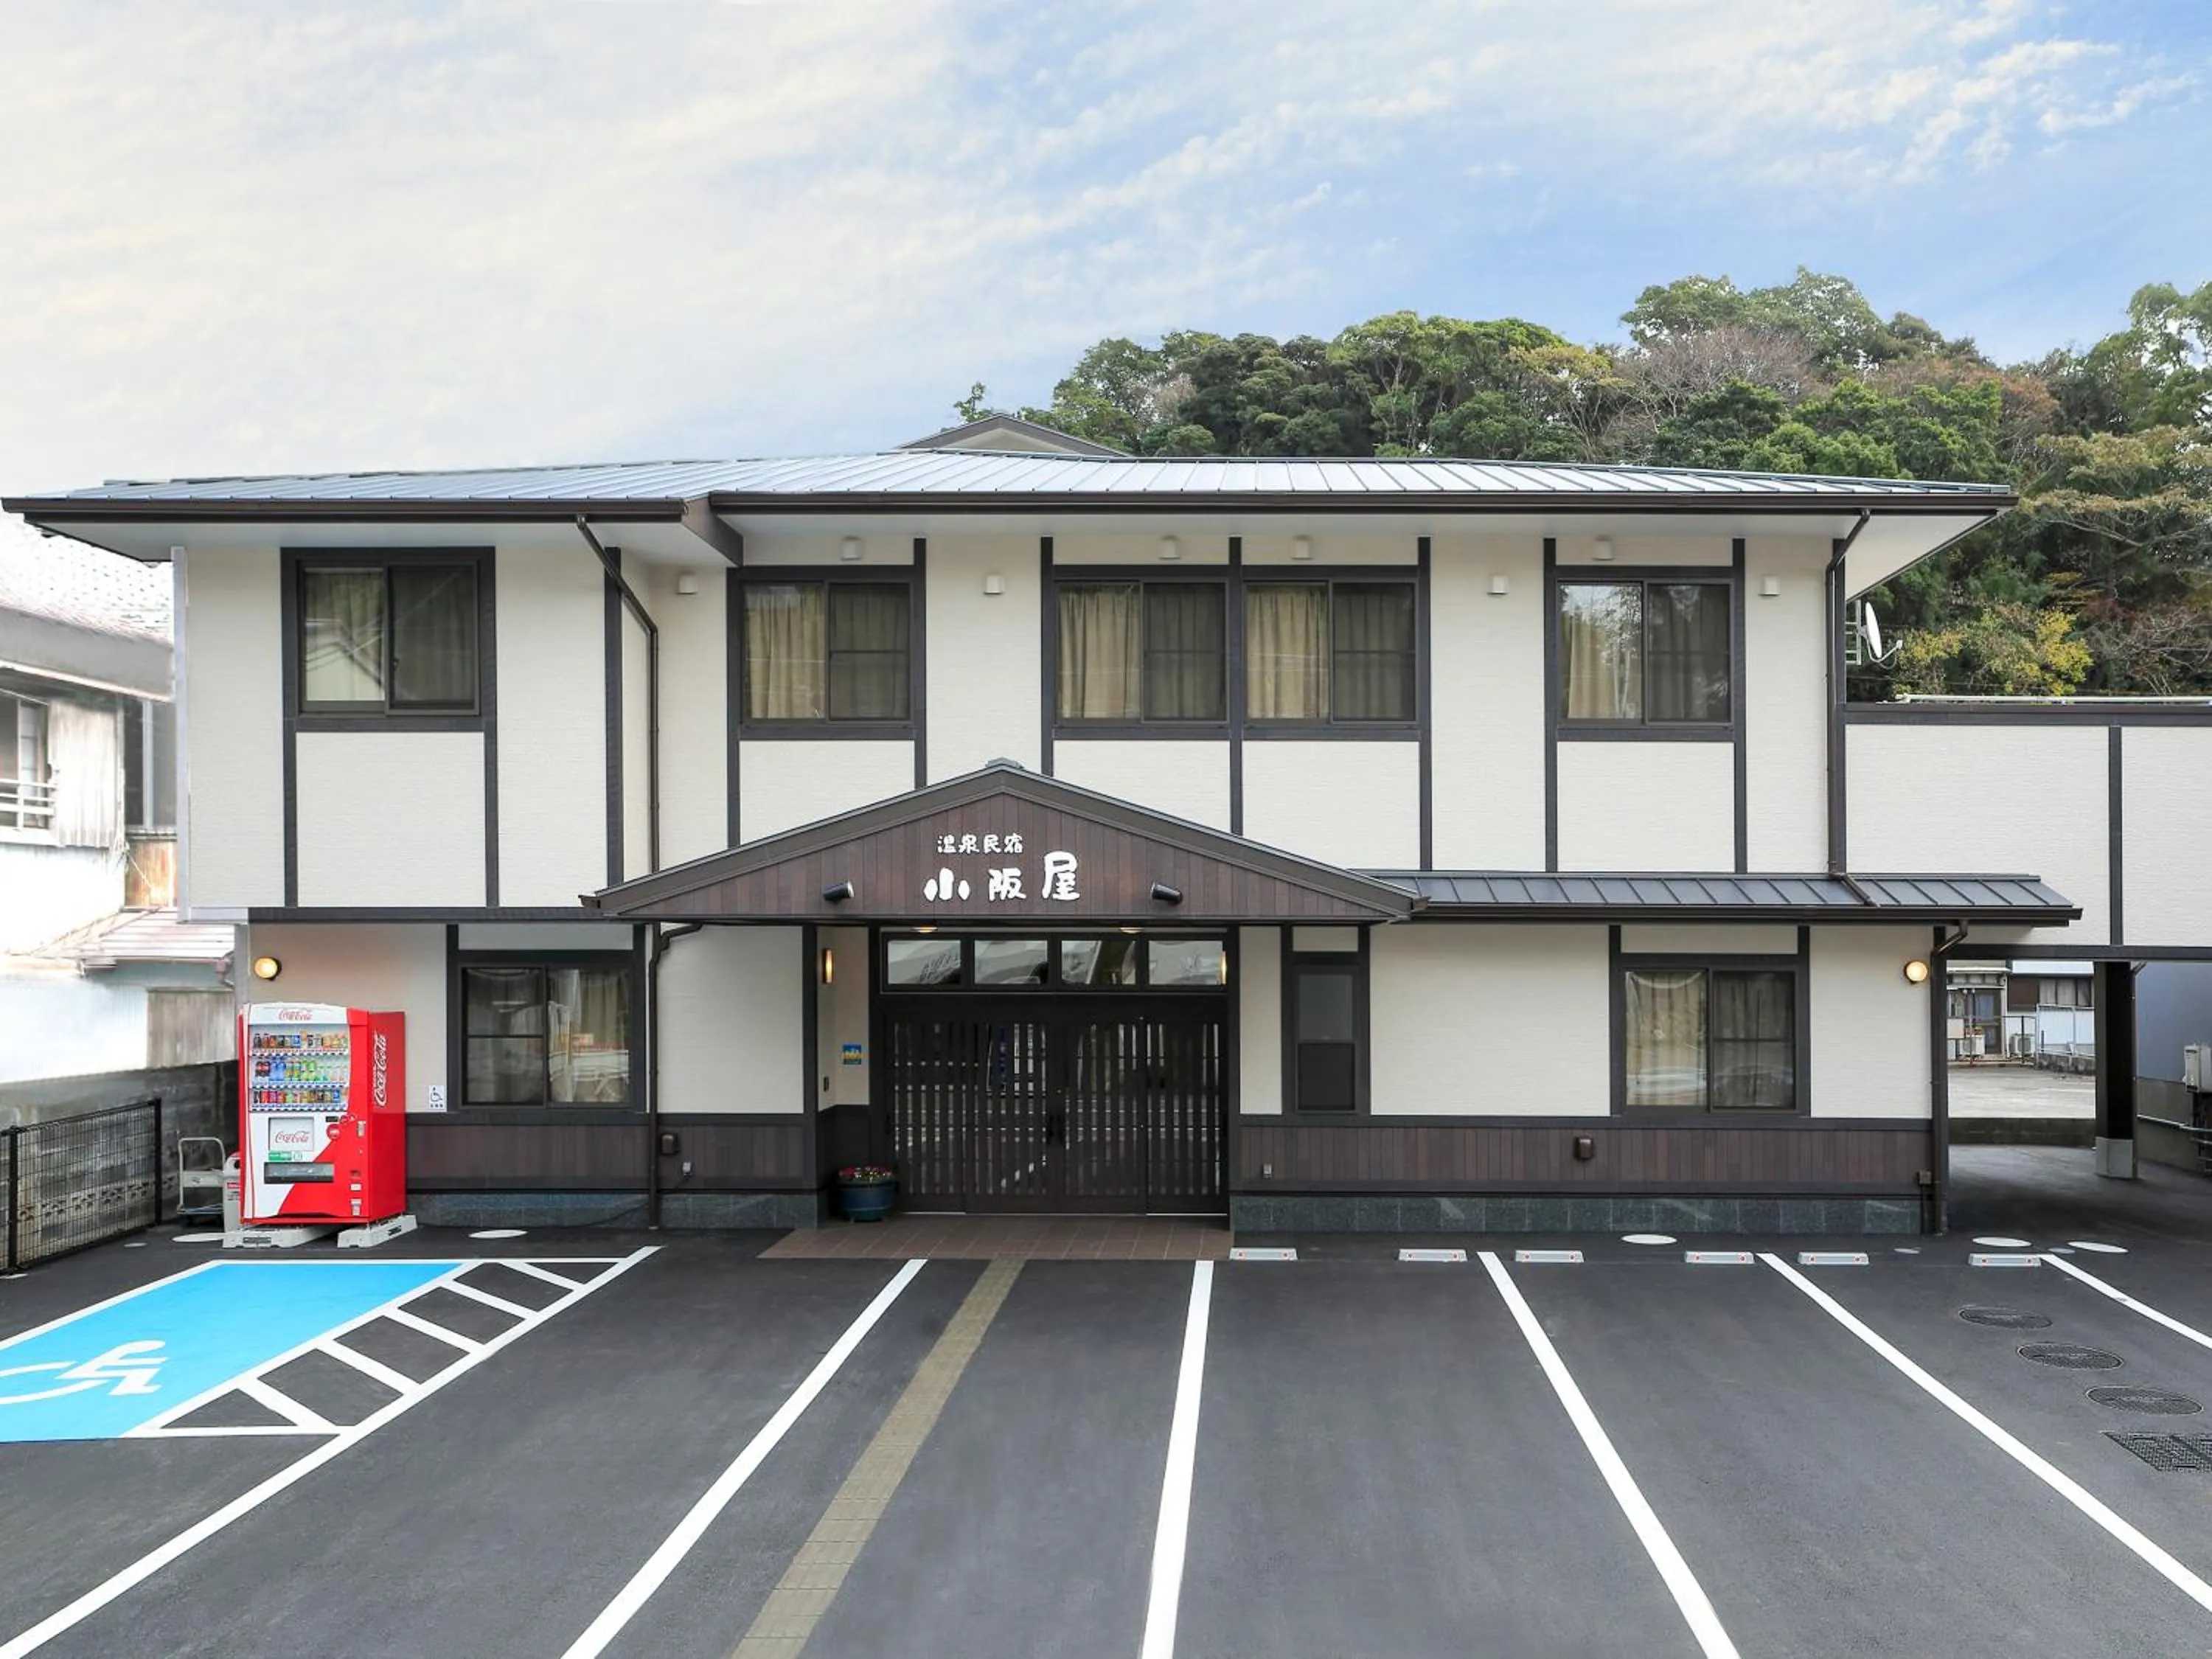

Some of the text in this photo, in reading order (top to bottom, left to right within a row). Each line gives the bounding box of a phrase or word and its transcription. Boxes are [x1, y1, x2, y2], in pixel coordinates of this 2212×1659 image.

[937, 833, 1023, 854] 温泉民宿
[923, 851, 1080, 902] 小阪屋
[373, 1032, 387, 1107] Coca-Cola
